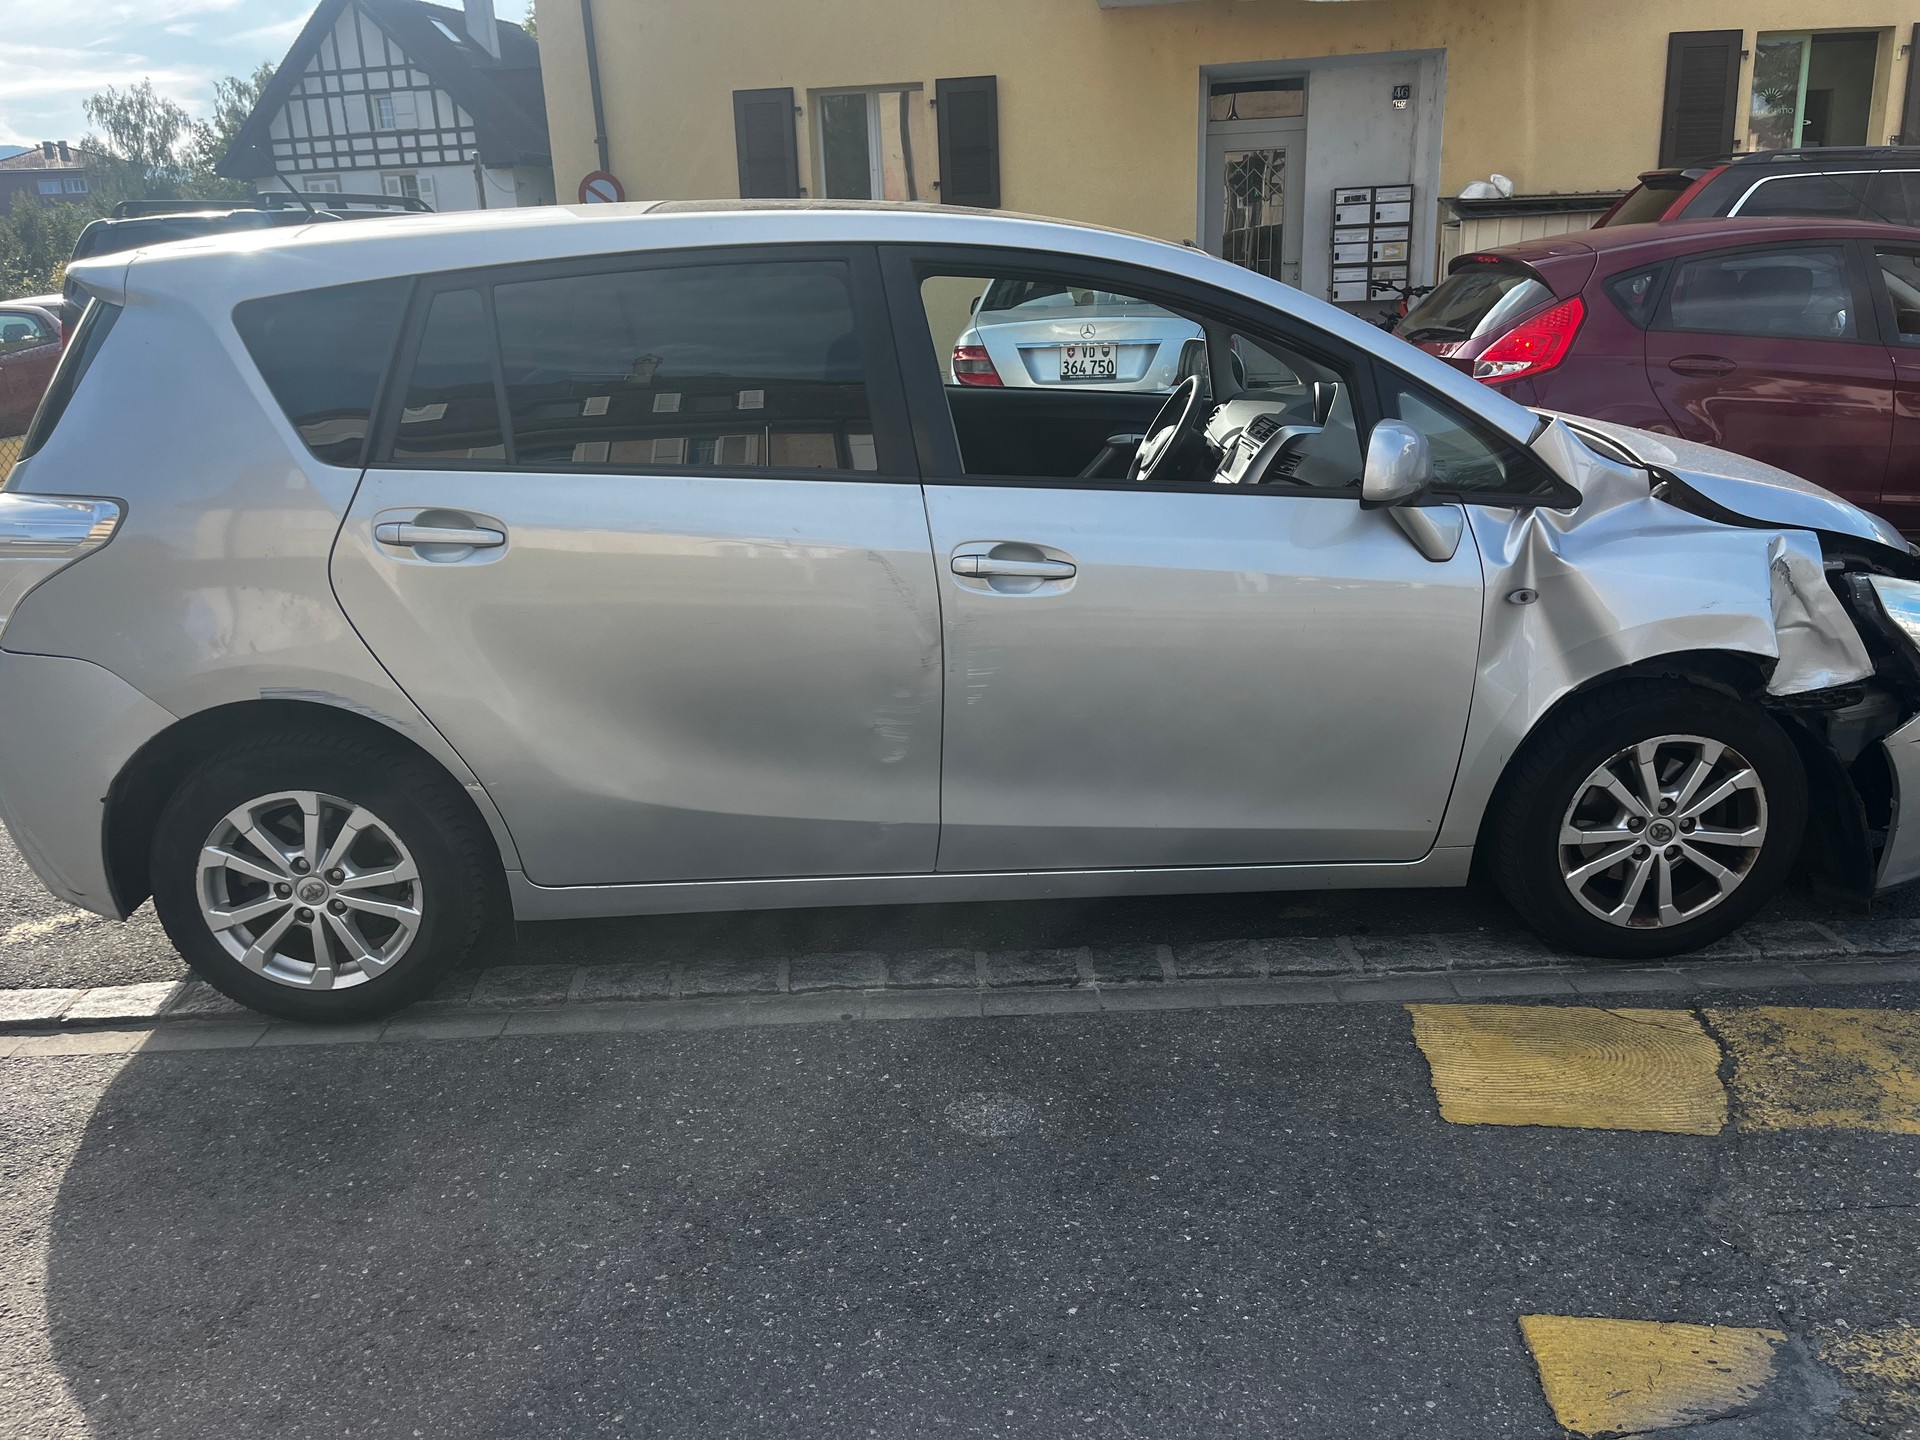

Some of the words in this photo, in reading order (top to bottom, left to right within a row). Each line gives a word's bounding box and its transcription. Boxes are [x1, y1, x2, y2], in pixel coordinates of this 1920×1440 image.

[1394, 87, 1408, 98] 46
[1082, 347, 1095, 358] VD
[1062, 360, 1086, 375] 364
[1090, 360, 1114, 374] 750
